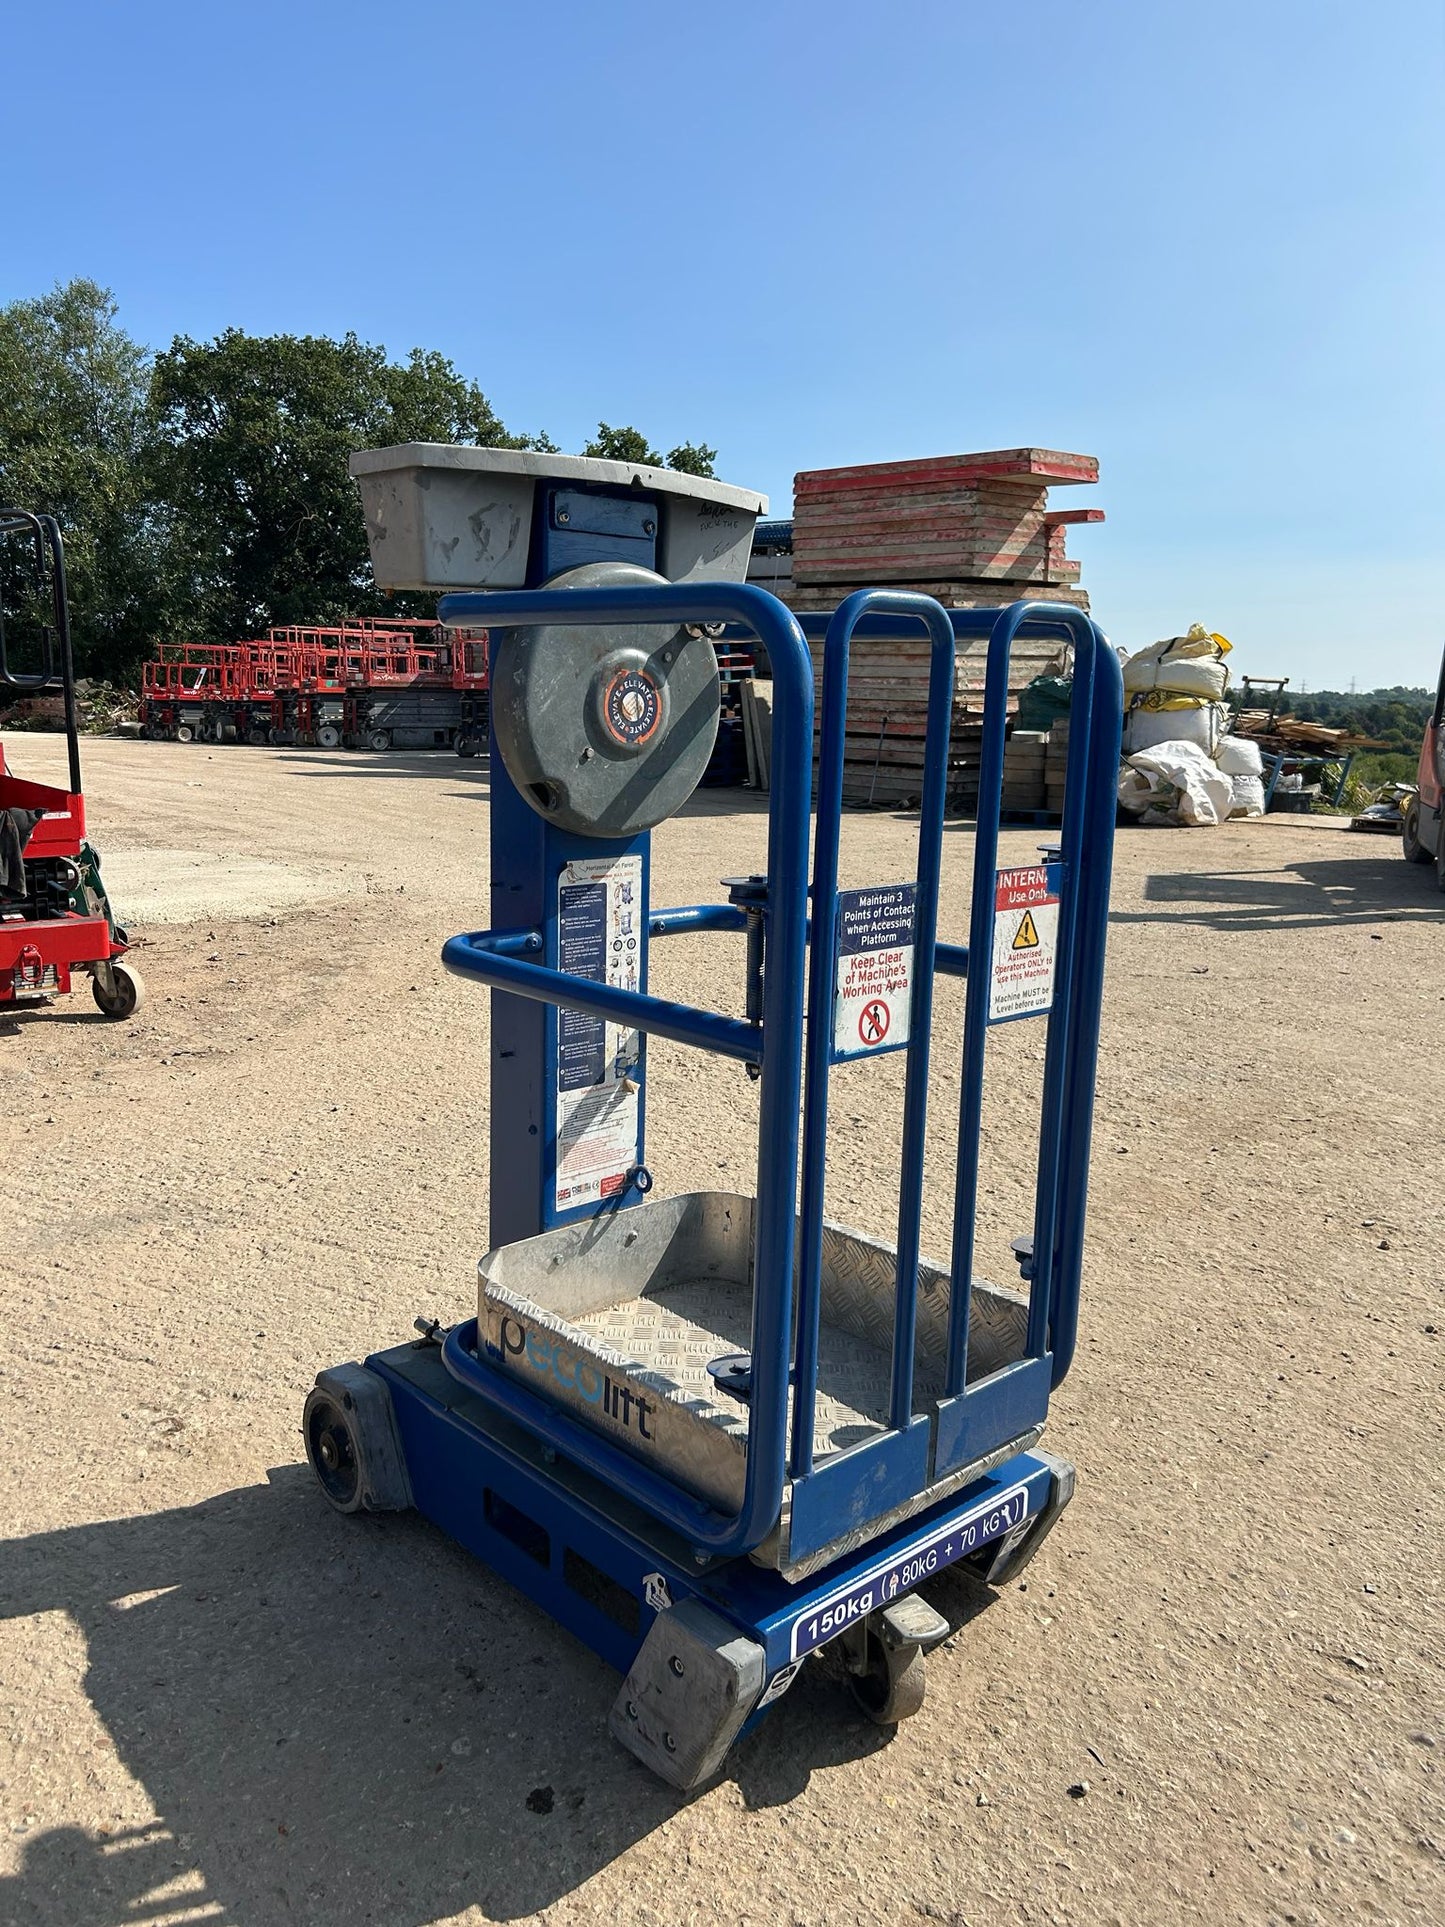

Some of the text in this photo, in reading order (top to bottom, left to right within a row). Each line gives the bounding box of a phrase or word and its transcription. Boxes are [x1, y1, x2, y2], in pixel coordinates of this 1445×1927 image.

[612, 680, 654, 734] ELEVATE ELEVATE ELEVATE
[999, 870, 1048, 889] INTERN
[859, 892, 903, 907] Maintain 3
[1009, 888, 1048, 903] Use Only
[844, 903, 915, 922] Points of Contact
[847, 917, 912, 935] when Accessing
[861, 932, 897, 946] Platform
[850, 951, 903, 971] Keep Clear
[1008, 949, 1042, 961] Authorised
[845, 964, 906, 985] of Machine's
[994, 956, 1053, 976] Operators ONLY to
[997, 967, 1049, 984] use this Machine
[842, 977, 908, 999] Working Area
[994, 986, 1049, 1004] Machine MUST be
[996, 997, 1046, 1014] Level before use
[807, 1590, 873, 1640] 150kg
[960, 1526, 976, 1551] 70
